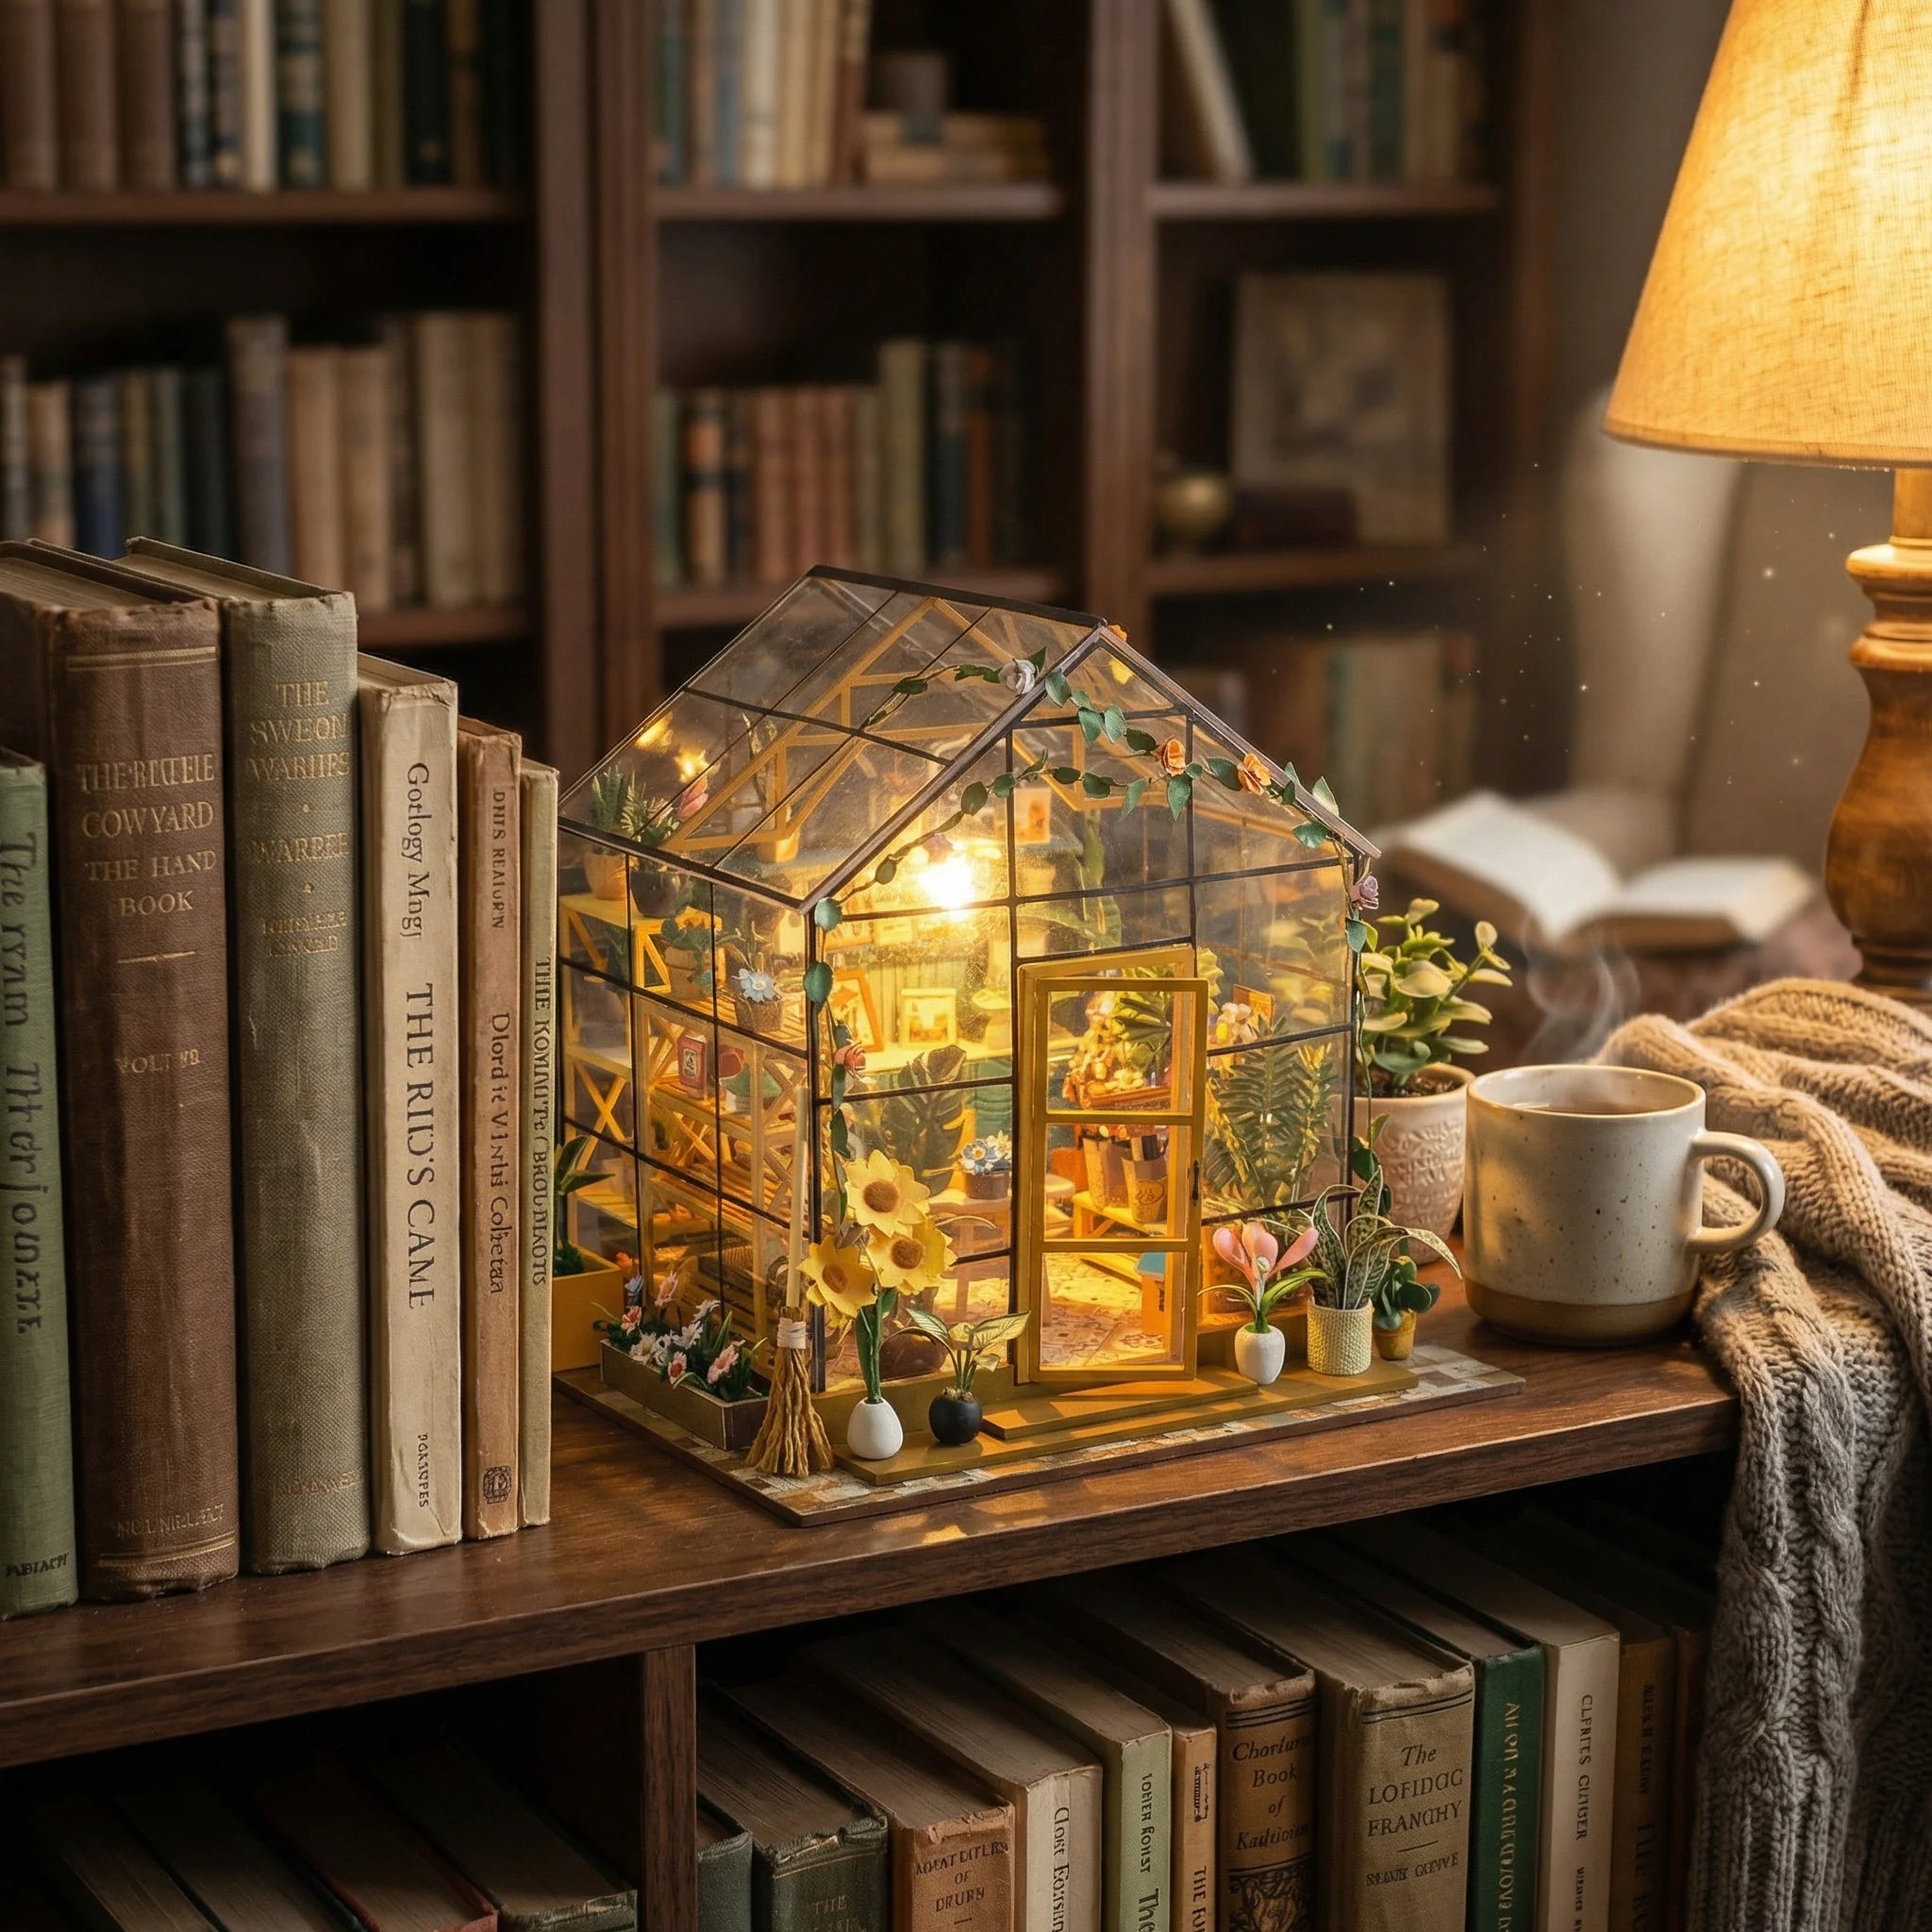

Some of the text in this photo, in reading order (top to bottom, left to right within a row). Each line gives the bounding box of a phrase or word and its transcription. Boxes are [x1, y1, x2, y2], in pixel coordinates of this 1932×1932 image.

[118, 890, 193, 917] BOOK
[406, 982, 434, 1069] THE
[1401, 1744, 1437, 1767] The
[1252, 1763, 1298, 1788] Book
[1268, 1795, 1287, 1817] of
[1192, 1865, 1208, 1903] THE
